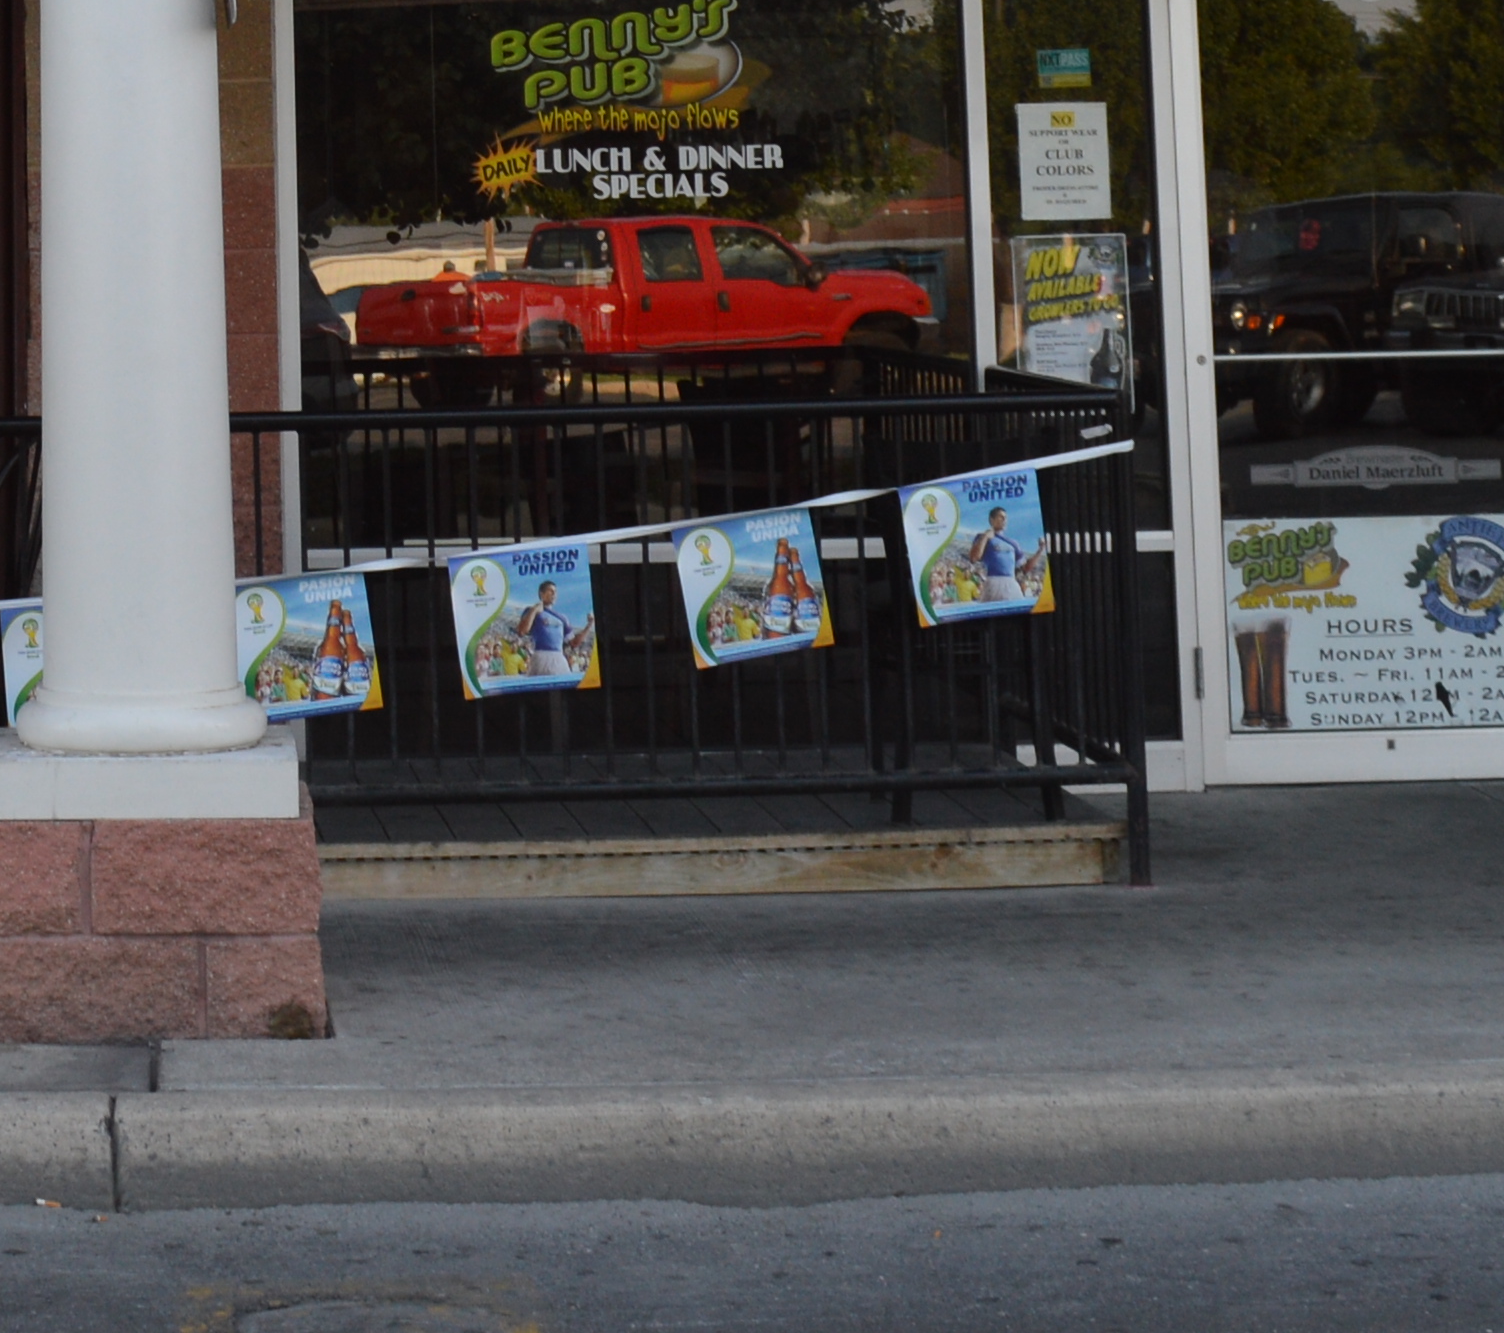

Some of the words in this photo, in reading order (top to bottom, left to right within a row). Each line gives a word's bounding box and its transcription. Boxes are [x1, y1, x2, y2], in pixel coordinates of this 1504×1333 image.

[524, 56, 653, 112] PUB
[539, 107, 592, 132] where
[598, 104, 628, 129] the
[634, 110, 680, 141] mojo
[687, 103, 740, 130] flows
[1051, 115, 1072, 125] NO
[1071, 129, 1097, 137] WEAR
[536, 147, 631, 173] LUNCH
[643, 146, 666, 171] &
[679, 144, 784, 170] DINNER
[1045, 149, 1084, 160] CLUB
[482, 154, 531, 183] DAILY
[1036, 165, 1095, 177] COLORS
[593, 172, 729, 200] SPECIALS
[1026, 245, 1081, 281] NOW
[1028, 273, 1102, 302] AVAILABLE
[1308, 466, 1360, 481] Daniel
[1366, 464, 1443, 479] Maerzluft
[962, 474, 1028, 492] PASSION
[967, 485, 1025, 503] UNITED
[751, 524, 799, 542] UNIDA
[512, 548, 579, 566] PASSION
[517, 560, 575, 576] UNITED
[1242, 556, 1299, 587] PUB
[304, 587, 353, 603] UNIDA
[1326, 619, 1413, 634] HOURS
[1319, 649, 1396, 661] MONDAY
[1404, 646, 1442, 660] 3PM
[1464, 645, 1502, 658] 2AM
[1289, 670, 1344, 683] TUES.
[1378, 668, 1414, 681] FRI.
[1425, 667, 1473, 680] 11AM
[1411, 688, 1460, 702] 12M
[1395, 710, 1444, 724] 12PM
